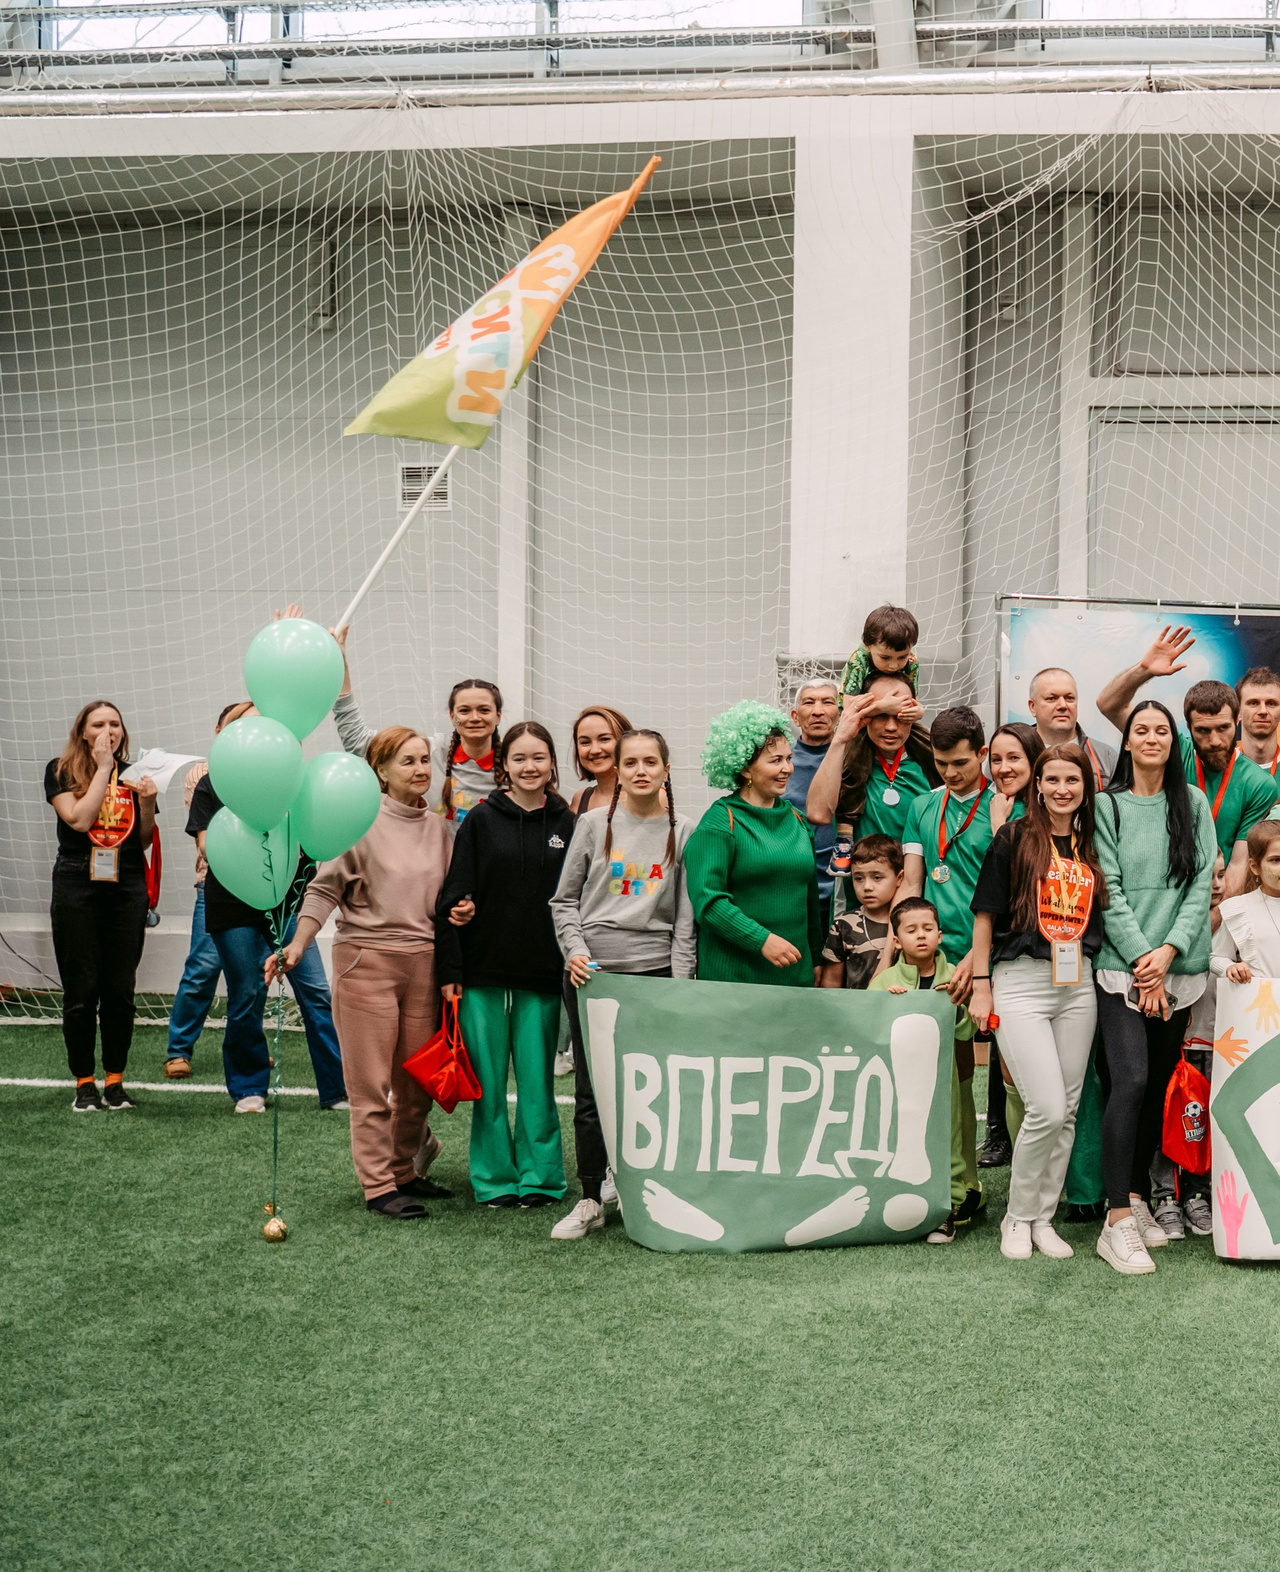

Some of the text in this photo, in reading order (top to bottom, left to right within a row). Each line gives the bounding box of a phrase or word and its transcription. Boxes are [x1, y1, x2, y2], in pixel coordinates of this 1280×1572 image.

[457, 289, 512, 415] СИТИ
[610, 861, 664, 880] BALA
[1047, 870, 1092, 888] eacher
[609, 879, 659, 896] CITY
